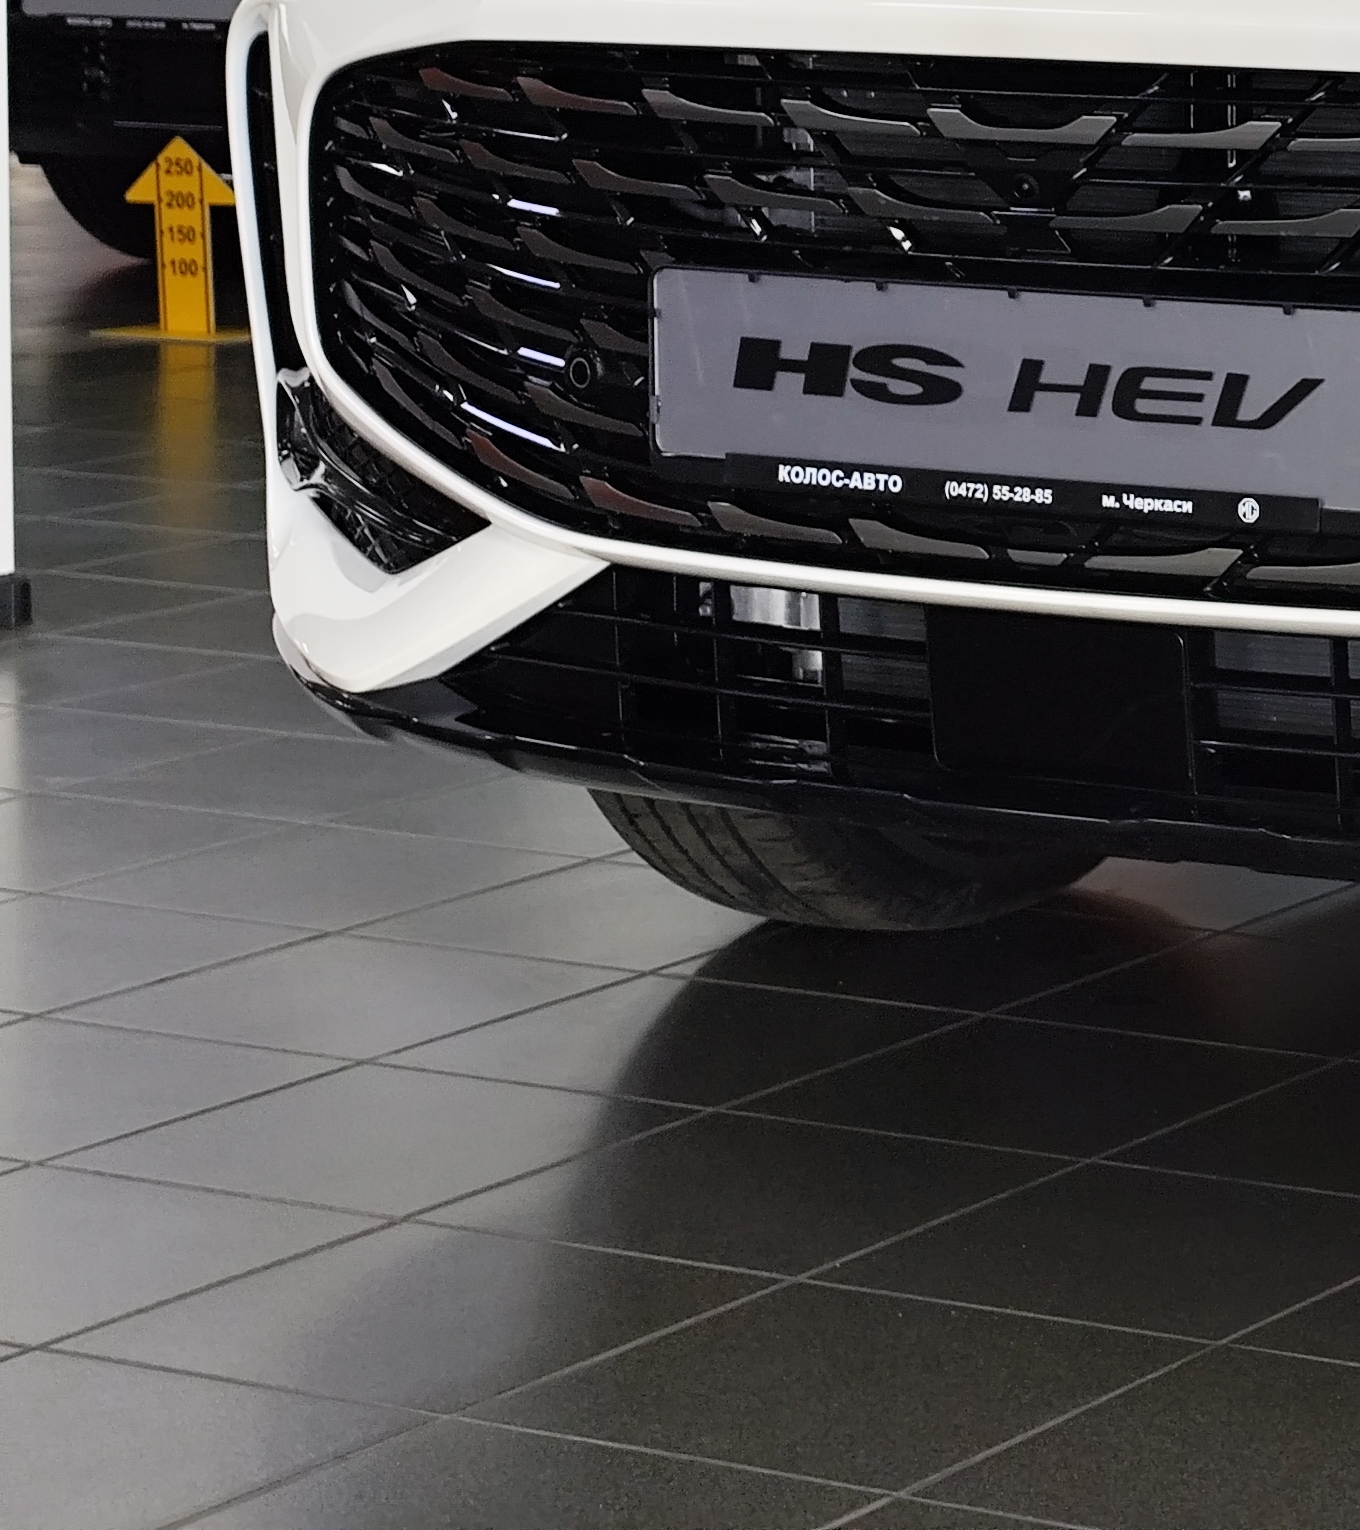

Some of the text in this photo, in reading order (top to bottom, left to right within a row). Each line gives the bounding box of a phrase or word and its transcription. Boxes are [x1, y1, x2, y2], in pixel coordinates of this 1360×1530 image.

[164, 156, 194, 176] 250
[165, 190, 196, 209] 200
[168, 225, 197, 245] 150
[170, 257, 199, 278] 100
[732, 336, 1326, 430] HS HEV
[778, 464, 903, 493] КОЛОС-АВТО
[944, 480, 989, 503] (0472)
[992, 484, 1053, 505] 55-28-85
[1101, 494, 1121, 509] м.
[1122, 493, 1193, 514] Черкаси
